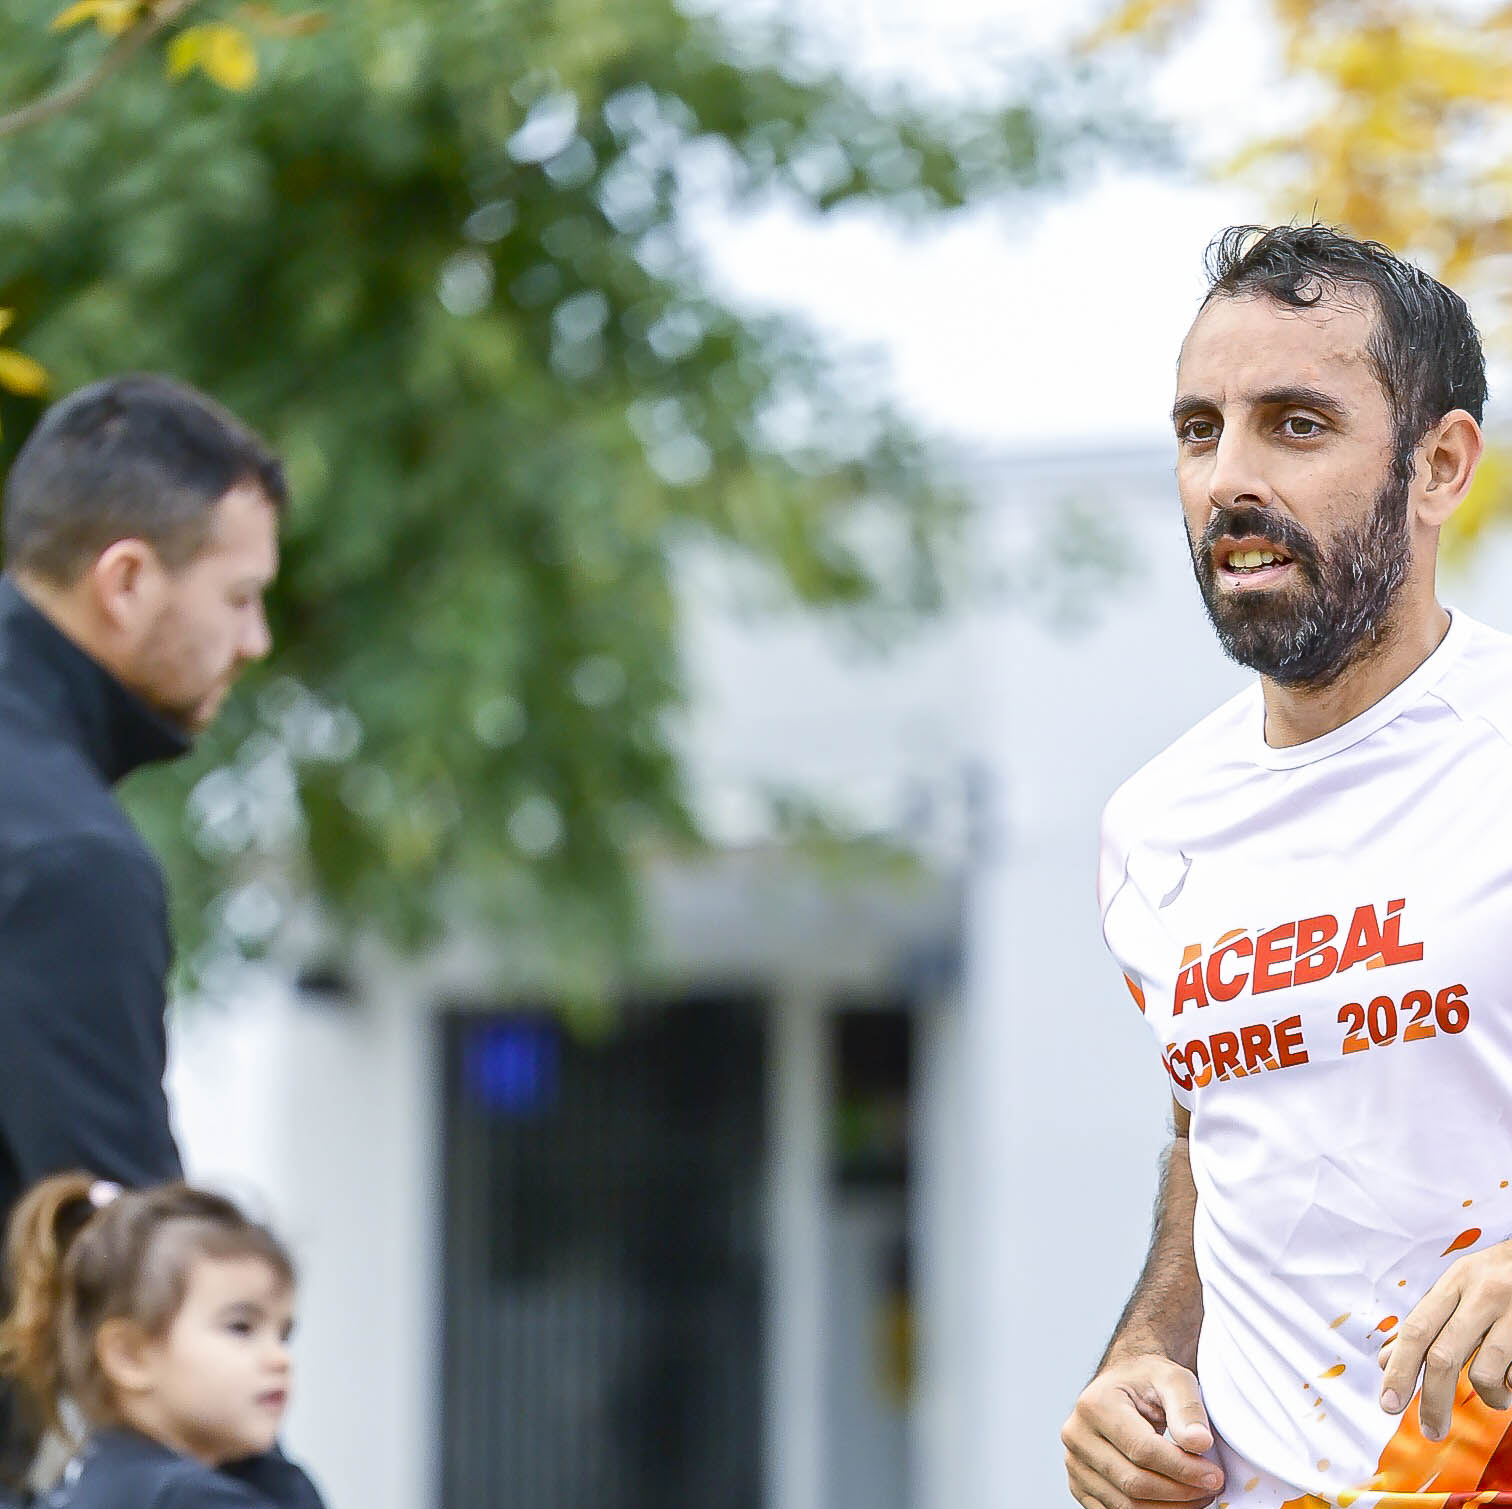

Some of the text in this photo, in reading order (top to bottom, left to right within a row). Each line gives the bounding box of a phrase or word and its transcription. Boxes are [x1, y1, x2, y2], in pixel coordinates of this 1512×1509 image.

[1172, 897, 1425, 1017] ACEBAL
[1163, 983, 1470, 1092] CORRE 2026
